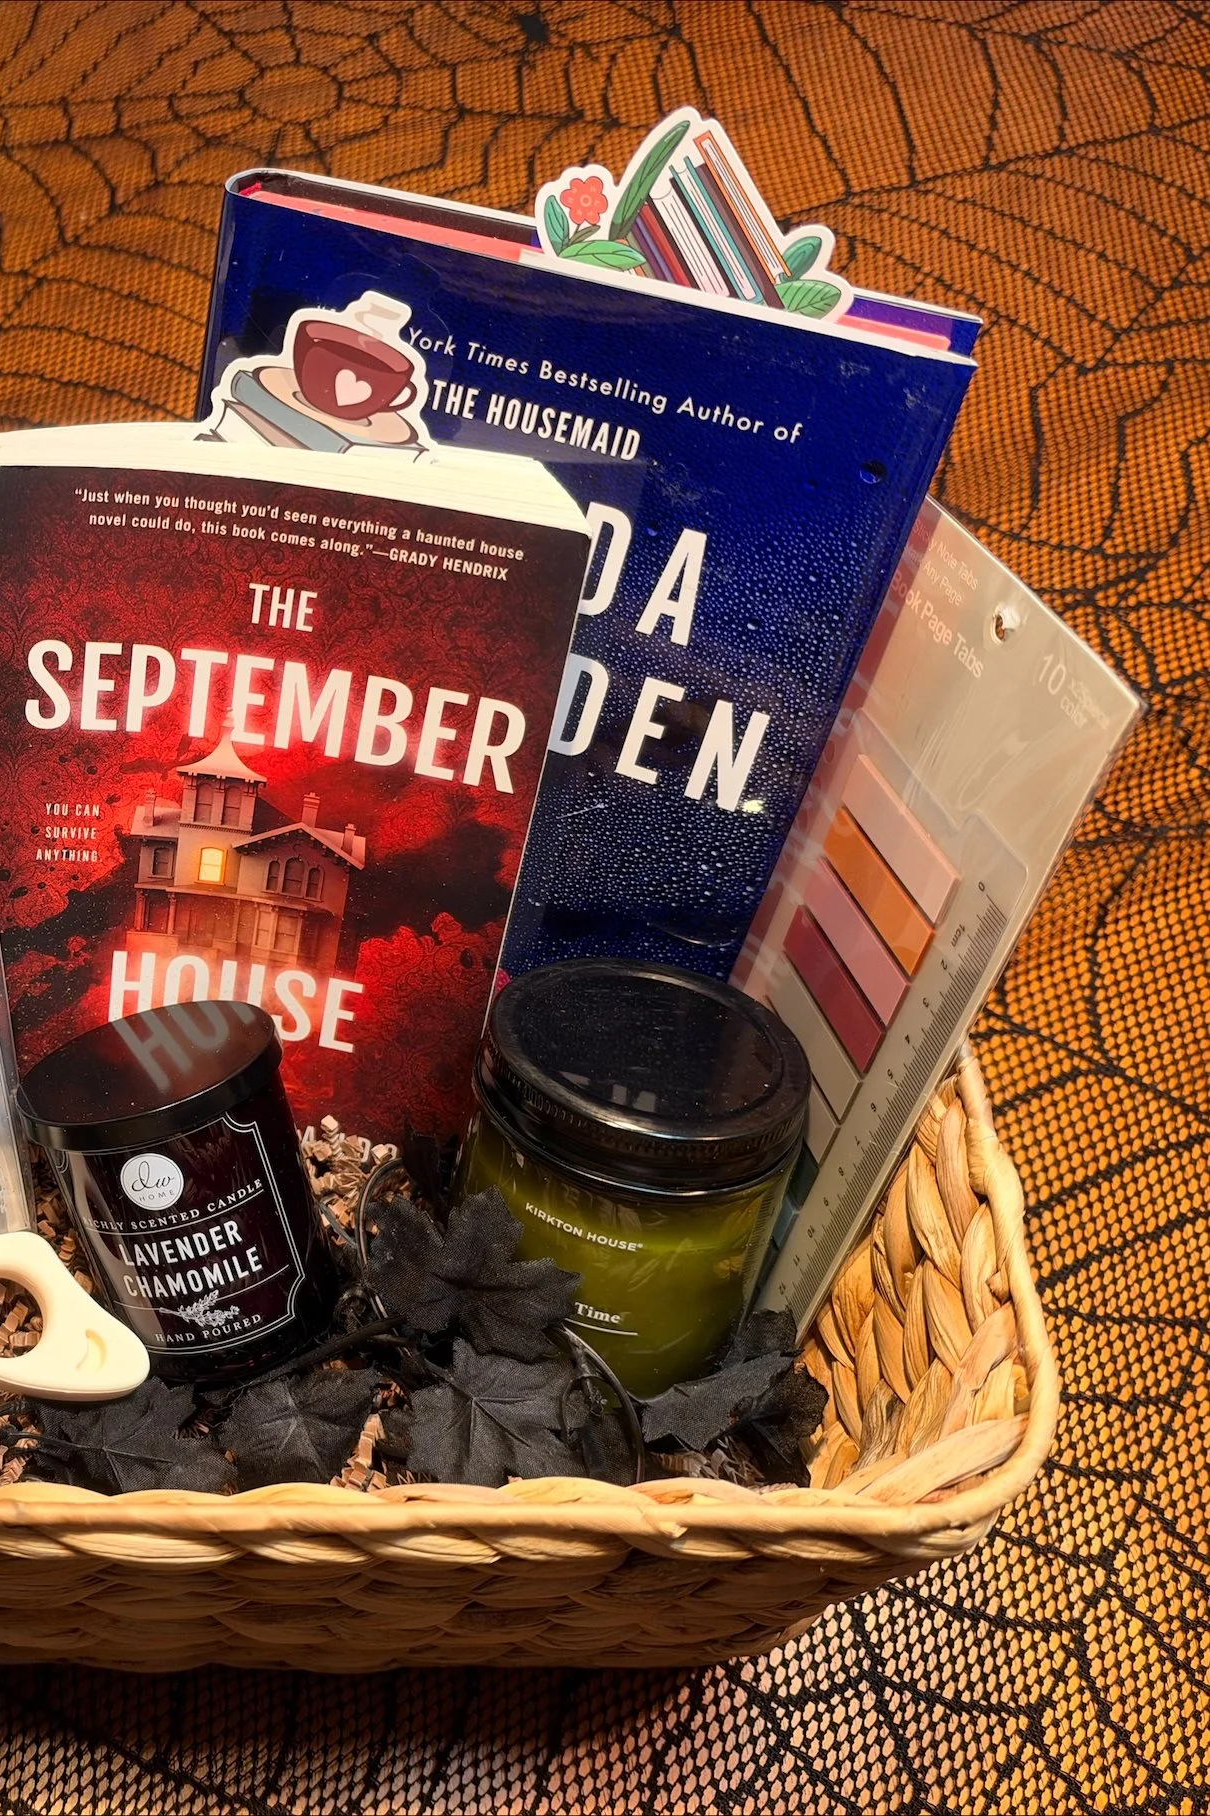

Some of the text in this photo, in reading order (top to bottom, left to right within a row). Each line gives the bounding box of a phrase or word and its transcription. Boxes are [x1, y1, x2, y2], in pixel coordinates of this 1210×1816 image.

[407, 327, 803, 446] York Times Bestselling Author of
[430, 379, 641, 462] THE HOUSEMAID
[113, 490, 151, 507] when
[155, 494, 180, 510] you
[184, 496, 238, 517] thought
[283, 508, 318, 525] seen
[322, 515, 397, 541] everything
[402, 530, 411, 541] a
[416, 528, 475, 553] haunted
[479, 539, 525, 562] house
[89, 512, 127, 529] novel
[131, 515, 170, 531] could
[175, 517, 197, 535] do,
[201, 520, 228, 536] this
[232, 524, 266, 542] book
[270, 530, 316, 549] comes
[442, 556, 509, 582] HENDRIX
[922, 560, 963, 607] Any Page
[958, 561, 979, 591] Tabs
[249, 582, 318, 633] THE
[890, 571, 921, 614] Book
[921, 600, 953, 645] Page
[952, 632, 984, 679] Tabs
[1039, 653, 1067, 695] 10
[25, 639, 527, 794] SEPTEMBER
[45, 803, 100, 816] YOU CAN
[45, 826, 97, 840] SURVIVE
[977, 880, 986, 893] 0
[950, 923, 966, 948] 1cm
[940, 959, 948, 971] 2
[108, 950, 363, 1052] HOUSE
[922, 997, 930, 1009] 3
[904, 1033, 912, 1045] 4
[886, 1069, 894, 1080] 5
[854, 1135, 862, 1147] 7
[131, 1208, 200, 1231] SCENTED
[207, 1178, 263, 1212] CANDLE
[139, 1189, 175, 1202] HOME
[525, 1202, 582, 1238] KIRKTON
[119, 1220, 243, 1268] LAVENDER
[123, 1246, 263, 1299] CHAMOMILE
[155, 1313, 262, 1344] HAND POURED
[575, 1301, 621, 1324] Time
